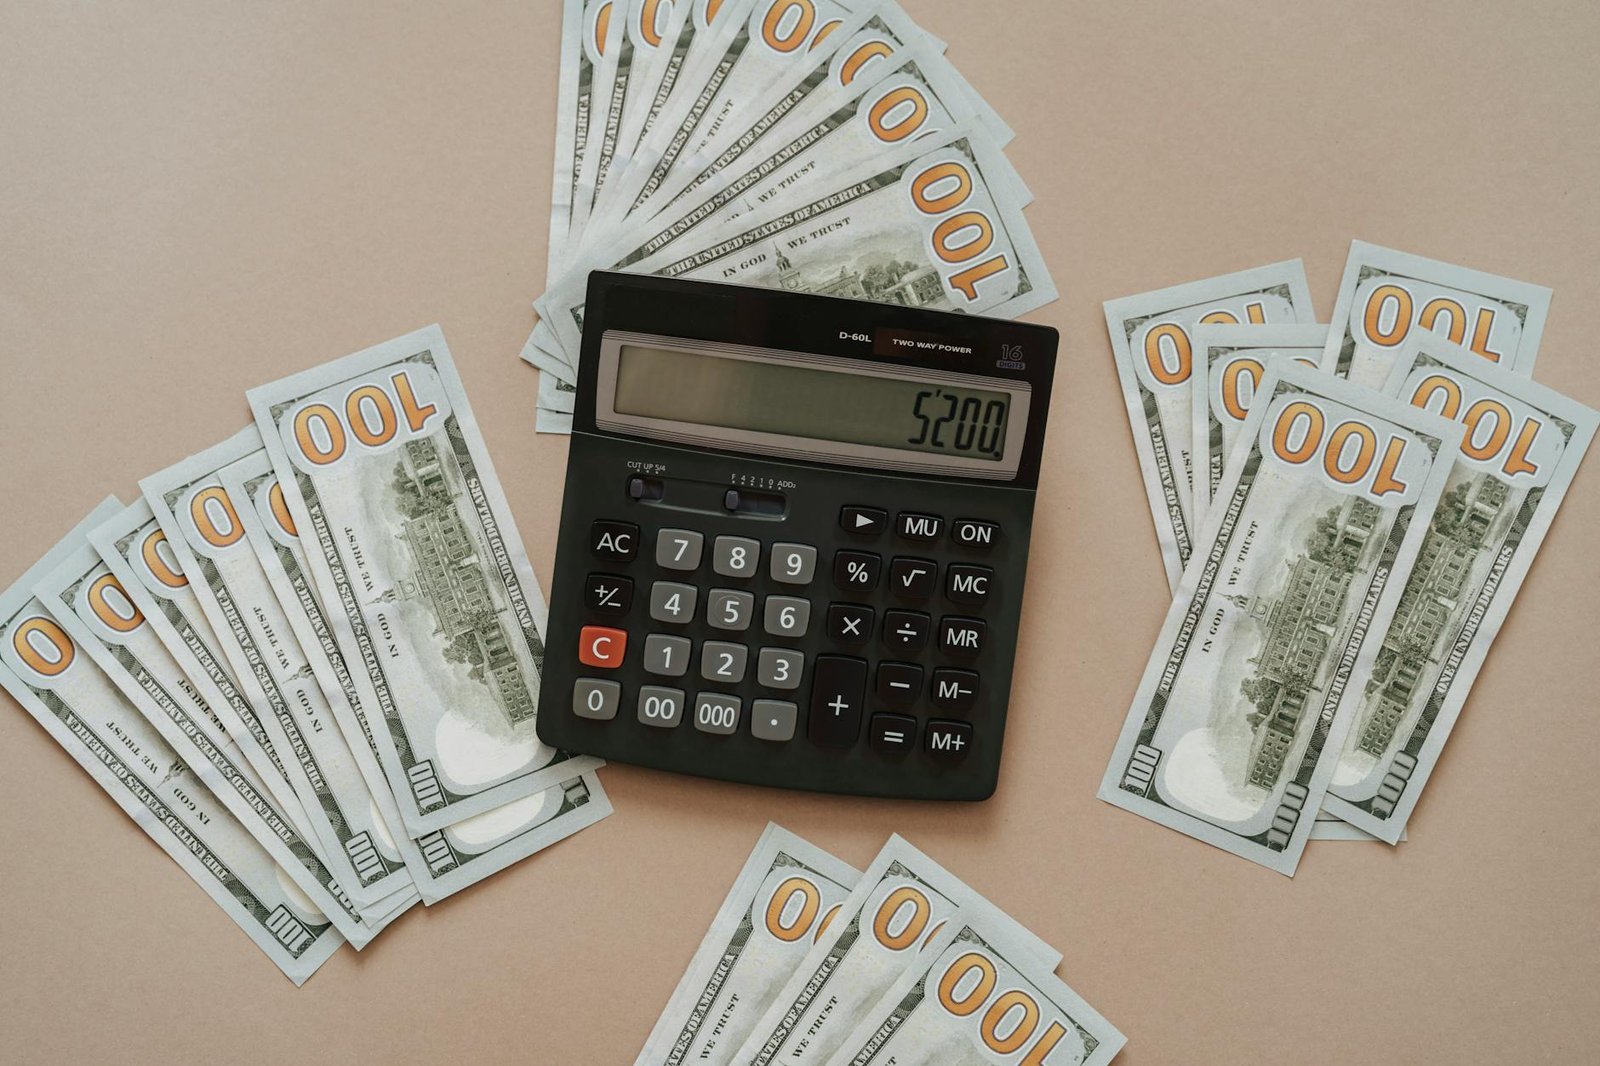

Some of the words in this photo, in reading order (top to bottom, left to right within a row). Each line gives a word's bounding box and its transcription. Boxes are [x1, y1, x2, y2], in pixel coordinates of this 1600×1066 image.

[603, 73, 629, 137] AMERICA
[690, 58, 734, 117] AMERICA
[704, 98, 737, 139] TRUST
[750, 87, 805, 135] AMERICA
[644, 230, 672, 254] THE
[668, 199, 717, 237] UNITED
[711, 168, 762, 207] STATES
[772, 121, 830, 165] AMERICA
[756, 186, 778, 204] WE
[776, 159, 818, 190] TRUST
[666, 256, 696, 277] THE
[693, 235, 745, 265] UNITED
[741, 212, 796, 245] STATES
[810, 179, 871, 215] AMERICA
[787, 234, 808, 250] WE
[809, 214, 852, 241] TRUST
[911, 162, 1009, 301] 100
[722, 264, 738, 278] IN
[738, 251, 767, 271] GOD
[839, 331, 872, 343] D-60L
[1364, 284, 1501, 363] 100
[892, 338, 914, 347] TWO
[916, 341, 937, 350] WAY
[938, 344, 972, 354] POWER
[1002, 344, 1023, 361] 16
[294, 371, 437, 465] 100
[1410, 375, 1542, 477] 100
[627, 461, 642, 469] CUT
[655, 464, 666, 472] 5/4
[1148, 422, 1174, 487] AMERICA
[1272, 401, 1407, 497] 100
[768, 478, 774, 486] 0
[466, 476, 498, 539] DOLLARS
[905, 517, 938, 537] MU
[307, 503, 340, 568] AMERICA
[343, 524, 366, 569] TRUST
[596, 532, 631, 554] AC
[674, 539, 689, 561] 7
[960, 524, 992, 543] ON
[1226, 565, 1242, 586] WE
[1235, 519, 1260, 564] TRUST
[489, 535, 522, 602] HUNDRED
[729, 546, 746, 569] 8
[786, 553, 802, 575] 9
[847, 561, 868, 583] %
[359, 570, 374, 591] WE
[952, 574, 988, 594] MC
[1157, 661, 1178, 692] THE
[1168, 611, 1198, 664] UNITED
[1188, 560, 1218, 615] STATES
[1215, 481, 1250, 545] AMERICA
[213, 585, 252, 649] AMERICA
[290, 575, 328, 639] AMERICA
[336, 581, 365, 636] STATES
[513, 598, 532, 628] ONE
[664, 593, 680, 615] 4
[724, 600, 739, 623] 5
[779, 606, 796, 629] 6
[1435, 664, 1457, 694] ONE
[1447, 603, 1486, 668] HUNDRED
[1476, 543, 1514, 607] DOLLARS
[251, 604, 280, 647] TRUST
[375, 611, 392, 640] GOD
[946, 628, 979, 648] MR
[1200, 637, 1213, 653] IN
[1207, 606, 1226, 636] GOD
[1318, 691, 1340, 721] ONE
[1329, 626, 1366, 695] HUNDRED
[1354, 565, 1390, 631] DOLLARS
[178, 625, 225, 685] AMERICA
[274, 648, 291, 669] WE
[356, 632, 384, 687] UNITED
[387, 642, 399, 658] IN
[592, 637, 611, 659] C
[662, 646, 673, 668] 1
[717, 652, 733, 675] 2
[252, 662, 286, 716] STATES
[773, 659, 790, 681] 3
[133, 668, 184, 723] AMERICA
[175, 676, 212, 715] TRUST
[294, 687, 315, 716] GOD
[375, 684, 395, 715] THE
[587, 689, 604, 711] 0
[644, 696, 675, 720] 00
[699, 703, 735, 727] 000
[62, 712, 116, 766] AMERICA
[104, 718, 143, 756] TRUST
[209, 713, 228, 733] WE
[277, 711, 311, 765] UNITED
[309, 717, 323, 733] IN
[931, 731, 965, 751] M+
[139, 754, 160, 774] WE
[191, 732, 236, 779] STATES
[302, 761, 325, 792] THE
[1121, 744, 1162, 794] 100
[123, 773, 169, 820] STATES
[171, 786, 198, 812] GOD
[228, 772, 272, 819] UNITED
[408, 759, 446, 814] 100
[1372, 750, 1418, 818] 100
[162, 813, 207, 859] UNITED
[195, 809, 211, 826] IN
[266, 814, 293, 842] THE
[1268, 781, 1310, 850] 100
[200, 852, 228, 880] THE
[345, 830, 388, 885] 100
[265, 904, 316, 957] 100
[692, 950, 737, 1016] AMERICA
[791, 952, 839, 1015] AMERICA
[699, 1038, 716, 1060] WE
[711, 992, 742, 1037] TRUST
[791, 1037, 810, 1059] WE
[806, 994, 840, 1037] TRUST
